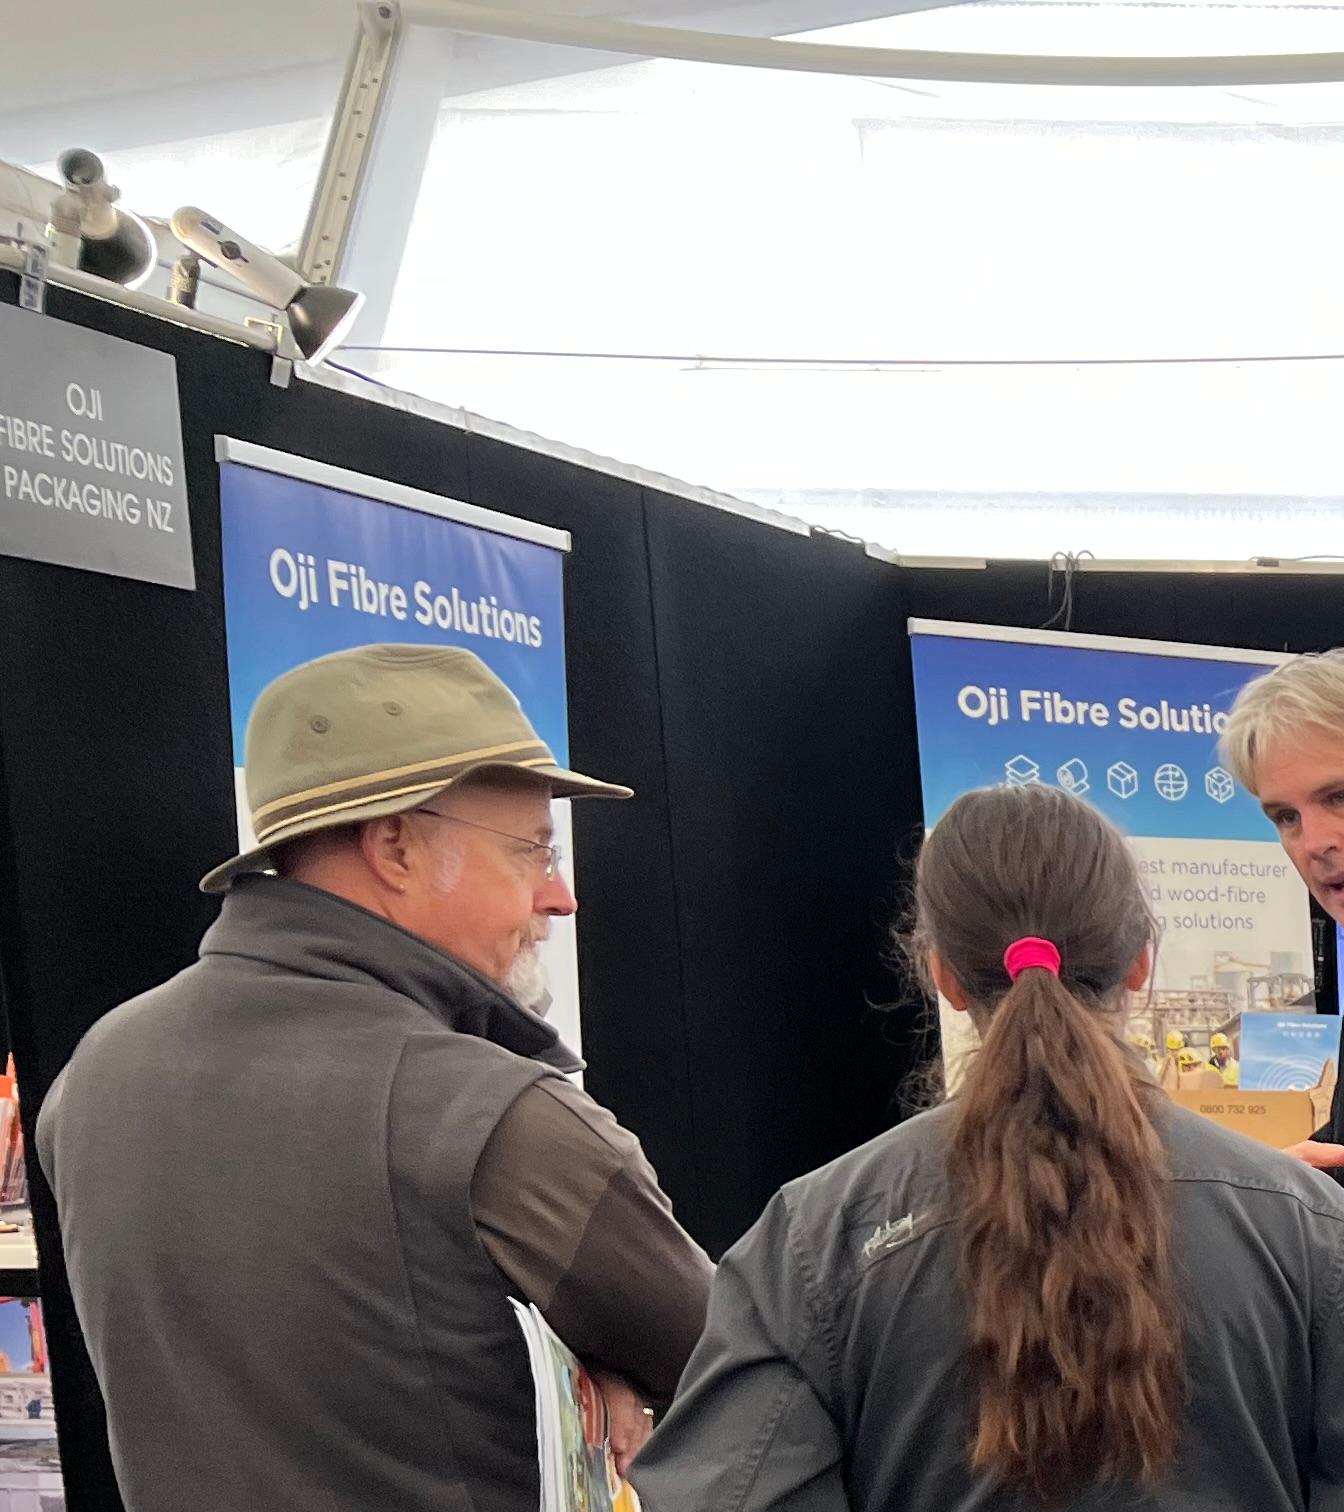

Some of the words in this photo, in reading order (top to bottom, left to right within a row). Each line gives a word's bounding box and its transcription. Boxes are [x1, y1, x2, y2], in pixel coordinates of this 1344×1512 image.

[66, 382, 103, 421] OJI
[61, 429, 174, 486] SOLUTIONS
[4, 465, 141, 524] PACKAGING
[146, 498, 174, 532] NZ
[269, 548, 318, 610] Oji
[327, 559, 408, 620] Fibre
[413, 580, 542, 647] Solutions
[957, 685, 1009, 725] Oji
[1020, 689, 1110, 727] Fibre
[1118, 697, 1230, 735] Solutio
[1172, 859, 1287, 878] manufacturer
[1168, 887, 1266, 903] wood-fibre
[1173, 914, 1254, 930] solutions
